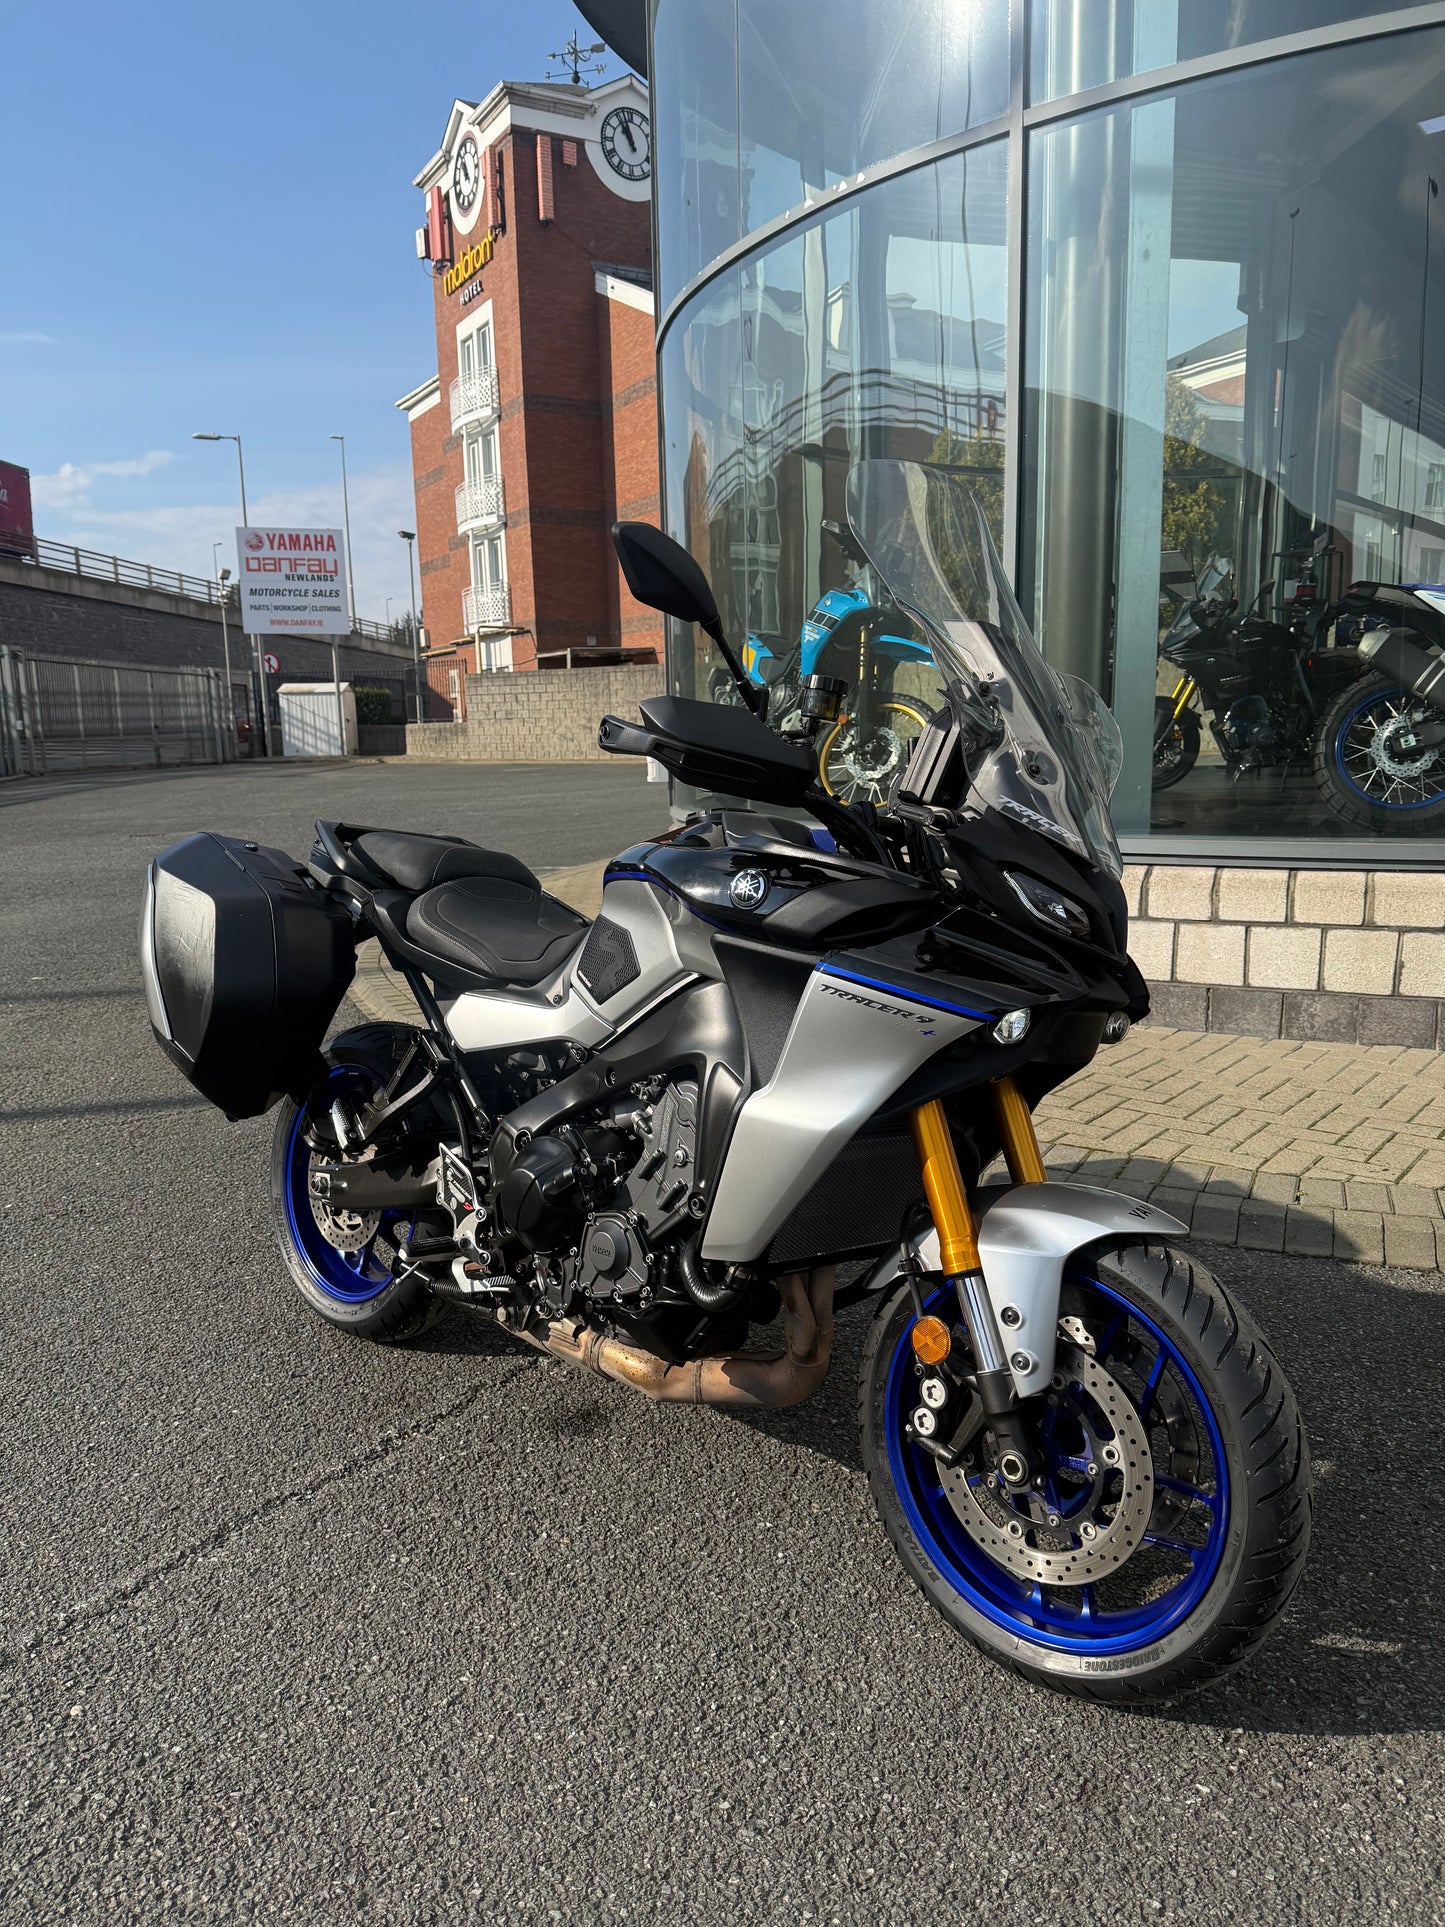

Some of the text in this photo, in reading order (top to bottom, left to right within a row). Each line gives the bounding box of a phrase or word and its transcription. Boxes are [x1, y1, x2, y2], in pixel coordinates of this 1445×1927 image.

[443, 238, 490, 297] maldron
[459, 279, 482, 306] HOTEL
[265, 532, 337, 552] YAMAHA
[284, 573, 335, 582] NEWLANDS
[248, 587, 341, 598] MOTORCYCLE SALES
[249, 604, 342, 613] PARTS WORKSHOP CLOTHING
[998, 794, 1083, 843] TRACER
[818, 983, 915, 1019] TRACER
[1084, 1646, 1161, 1672] BRIDGESTONE
